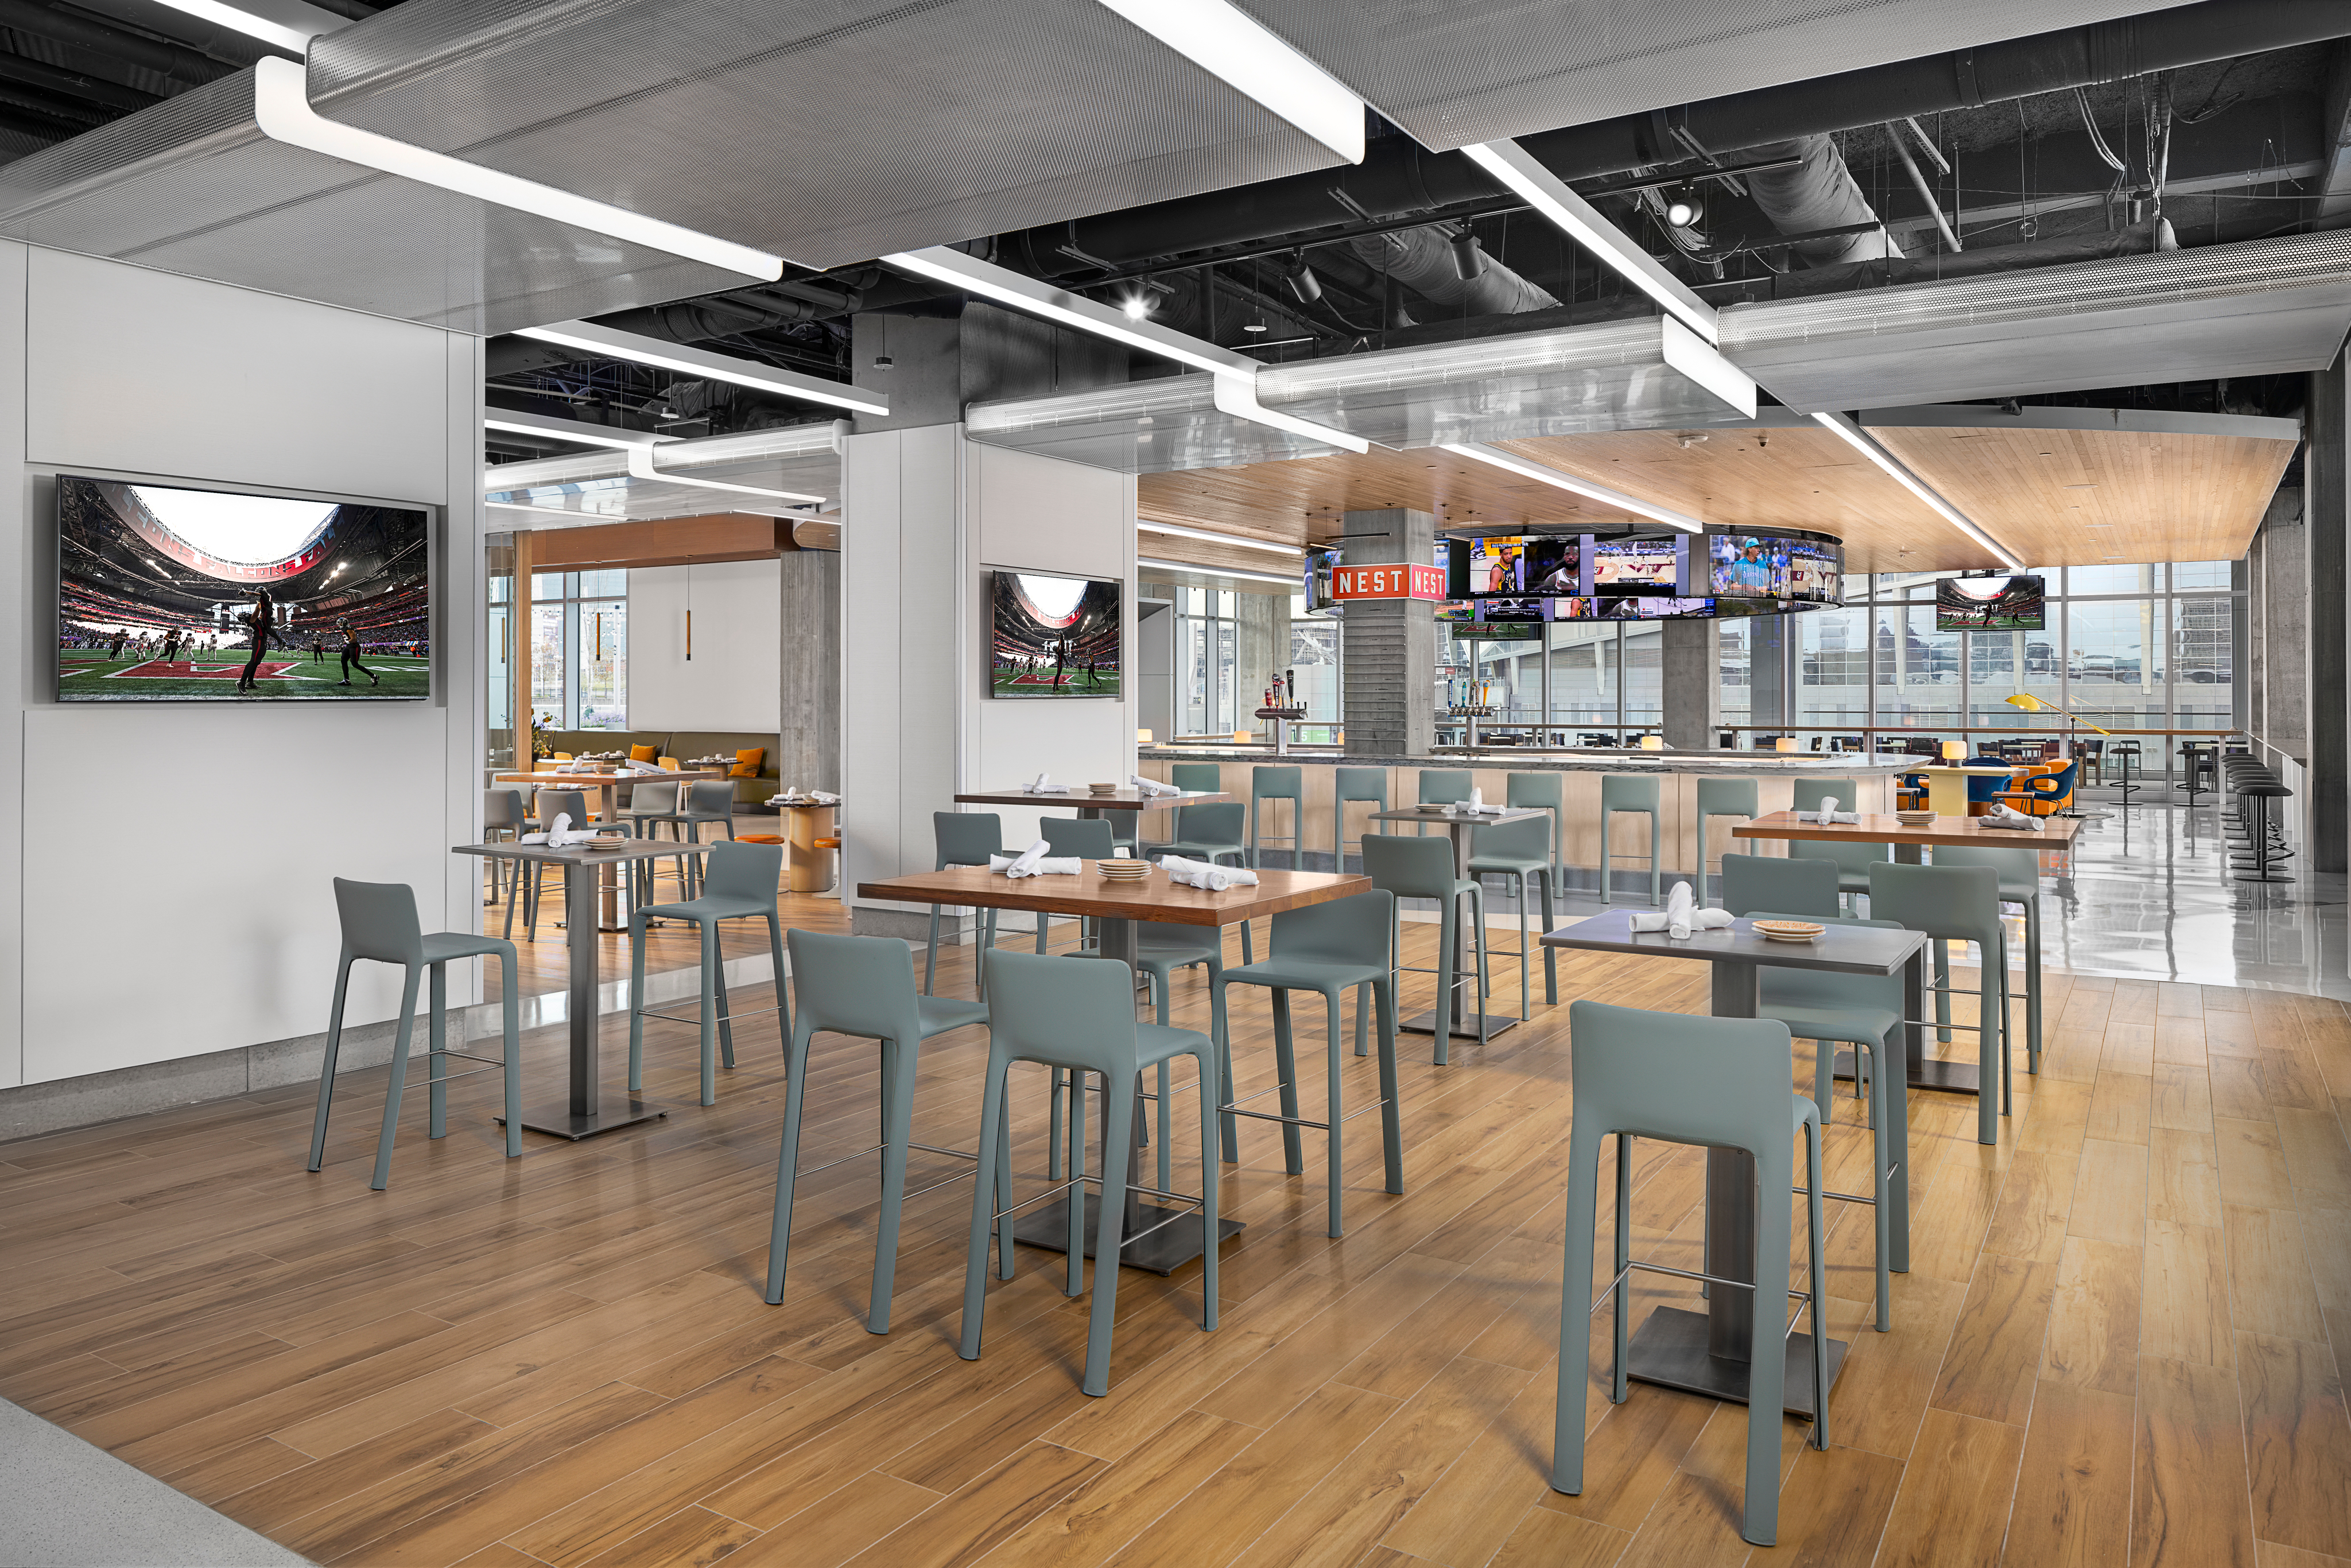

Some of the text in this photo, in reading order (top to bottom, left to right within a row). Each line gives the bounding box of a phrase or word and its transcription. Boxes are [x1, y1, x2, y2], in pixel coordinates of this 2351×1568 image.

[200, 556, 296, 579] FALCONS
[1339, 570, 1402, 593] NEST
[1415, 570, 1444, 595] NEST
[1040, 614, 1073, 626] FALCONS
